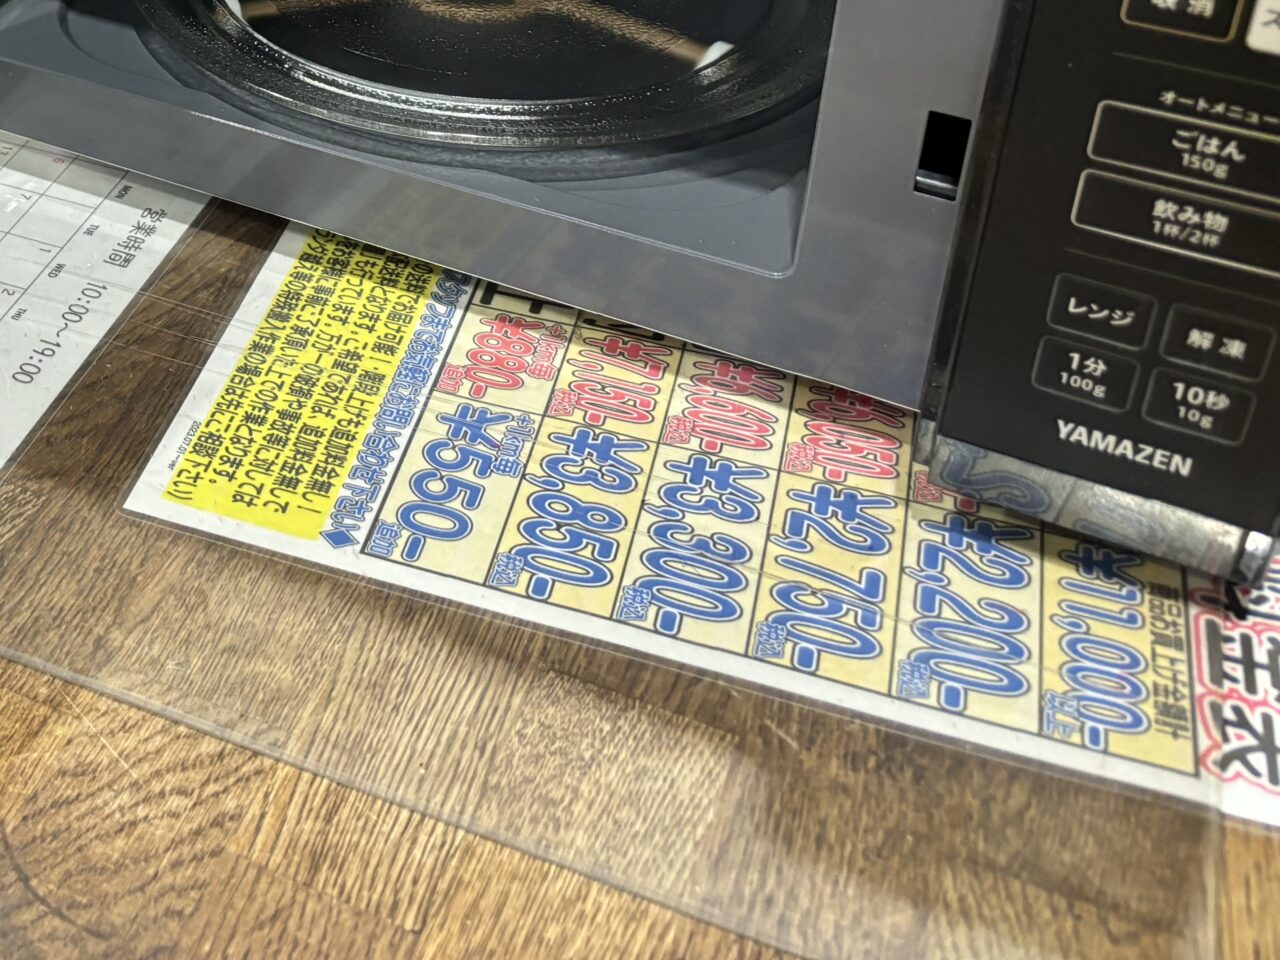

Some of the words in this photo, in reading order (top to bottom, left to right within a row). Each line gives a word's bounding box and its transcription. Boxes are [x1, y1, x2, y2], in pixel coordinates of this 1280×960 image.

[1159, 91, 1280, 124] オートメニュー
[1171, 129, 1246, 162] ごはん
[1182, 152, 1229, 179] 150g
[112, 184, 133, 200] MON
[82, 223, 100, 236] TUE
[1152, 199, 1229, 233] 飲み物
[101, 204, 171, 269] 営業時間
[45, 262, 66, 279] WED
[9, 307, 27, 321] THU
[1067, 297, 1135, 327] レンジ
[1186, 328, 1247, 360] 解凍
[434, 362, 470, 395] 追加
[1068, 352, 1107, 377] 1分
[1059, 371, 1106, 398] 100g
[1172, 382, 1230, 411] 10秒
[544, 386, 580, 421] 税込
[1176, 405, 1214, 429] 10g
[660, 413, 696, 449] 税込
[1056, 418, 1193, 476] YAMAZEN
[783, 440, 817, 477] 税込
[364, 517, 407, 560] 追加
[487, 550, 527, 594] 税込
[615, 581, 654, 628] 税込
[750, 618, 790, 665] 税込
[895, 656, 930, 705] 税込
